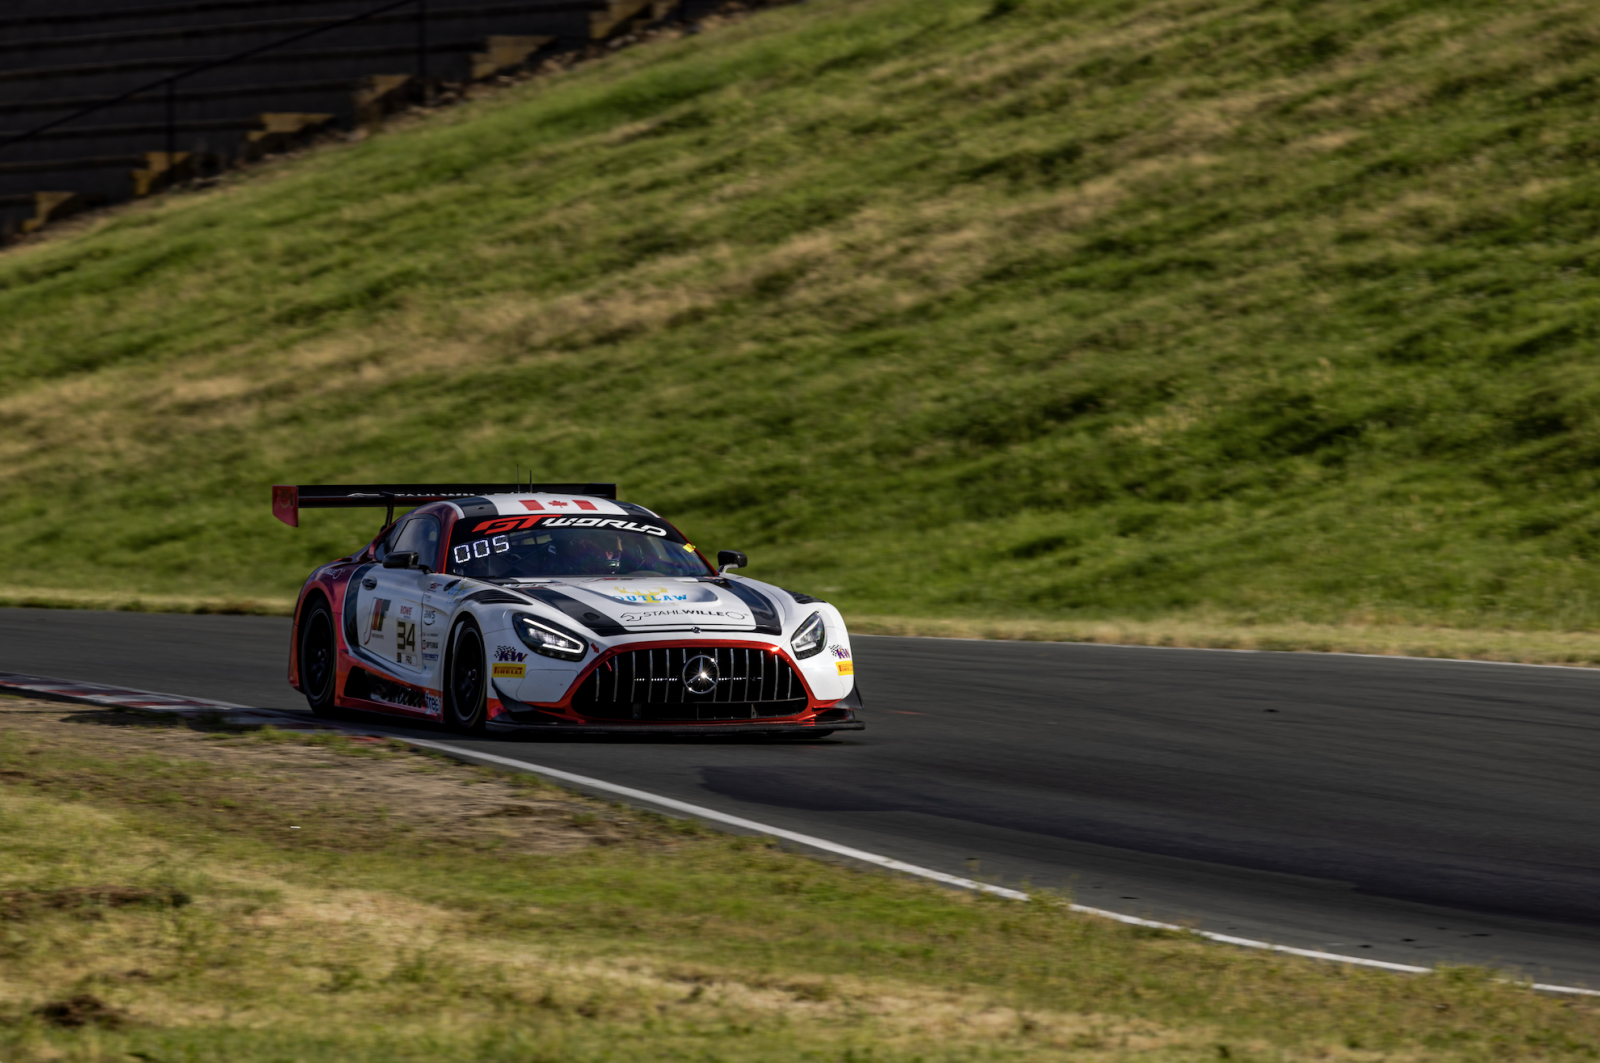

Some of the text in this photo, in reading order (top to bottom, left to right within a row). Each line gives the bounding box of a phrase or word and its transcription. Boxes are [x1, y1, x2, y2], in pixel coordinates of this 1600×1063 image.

[613, 594, 687, 602] OUTLAW
[400, 605, 413, 616] ROWE
[643, 609, 725, 618] STAHLWILLE
[397, 621, 416, 652] 34
[498, 650, 528, 662] KW
[494, 666, 523, 675] PIRELLI
